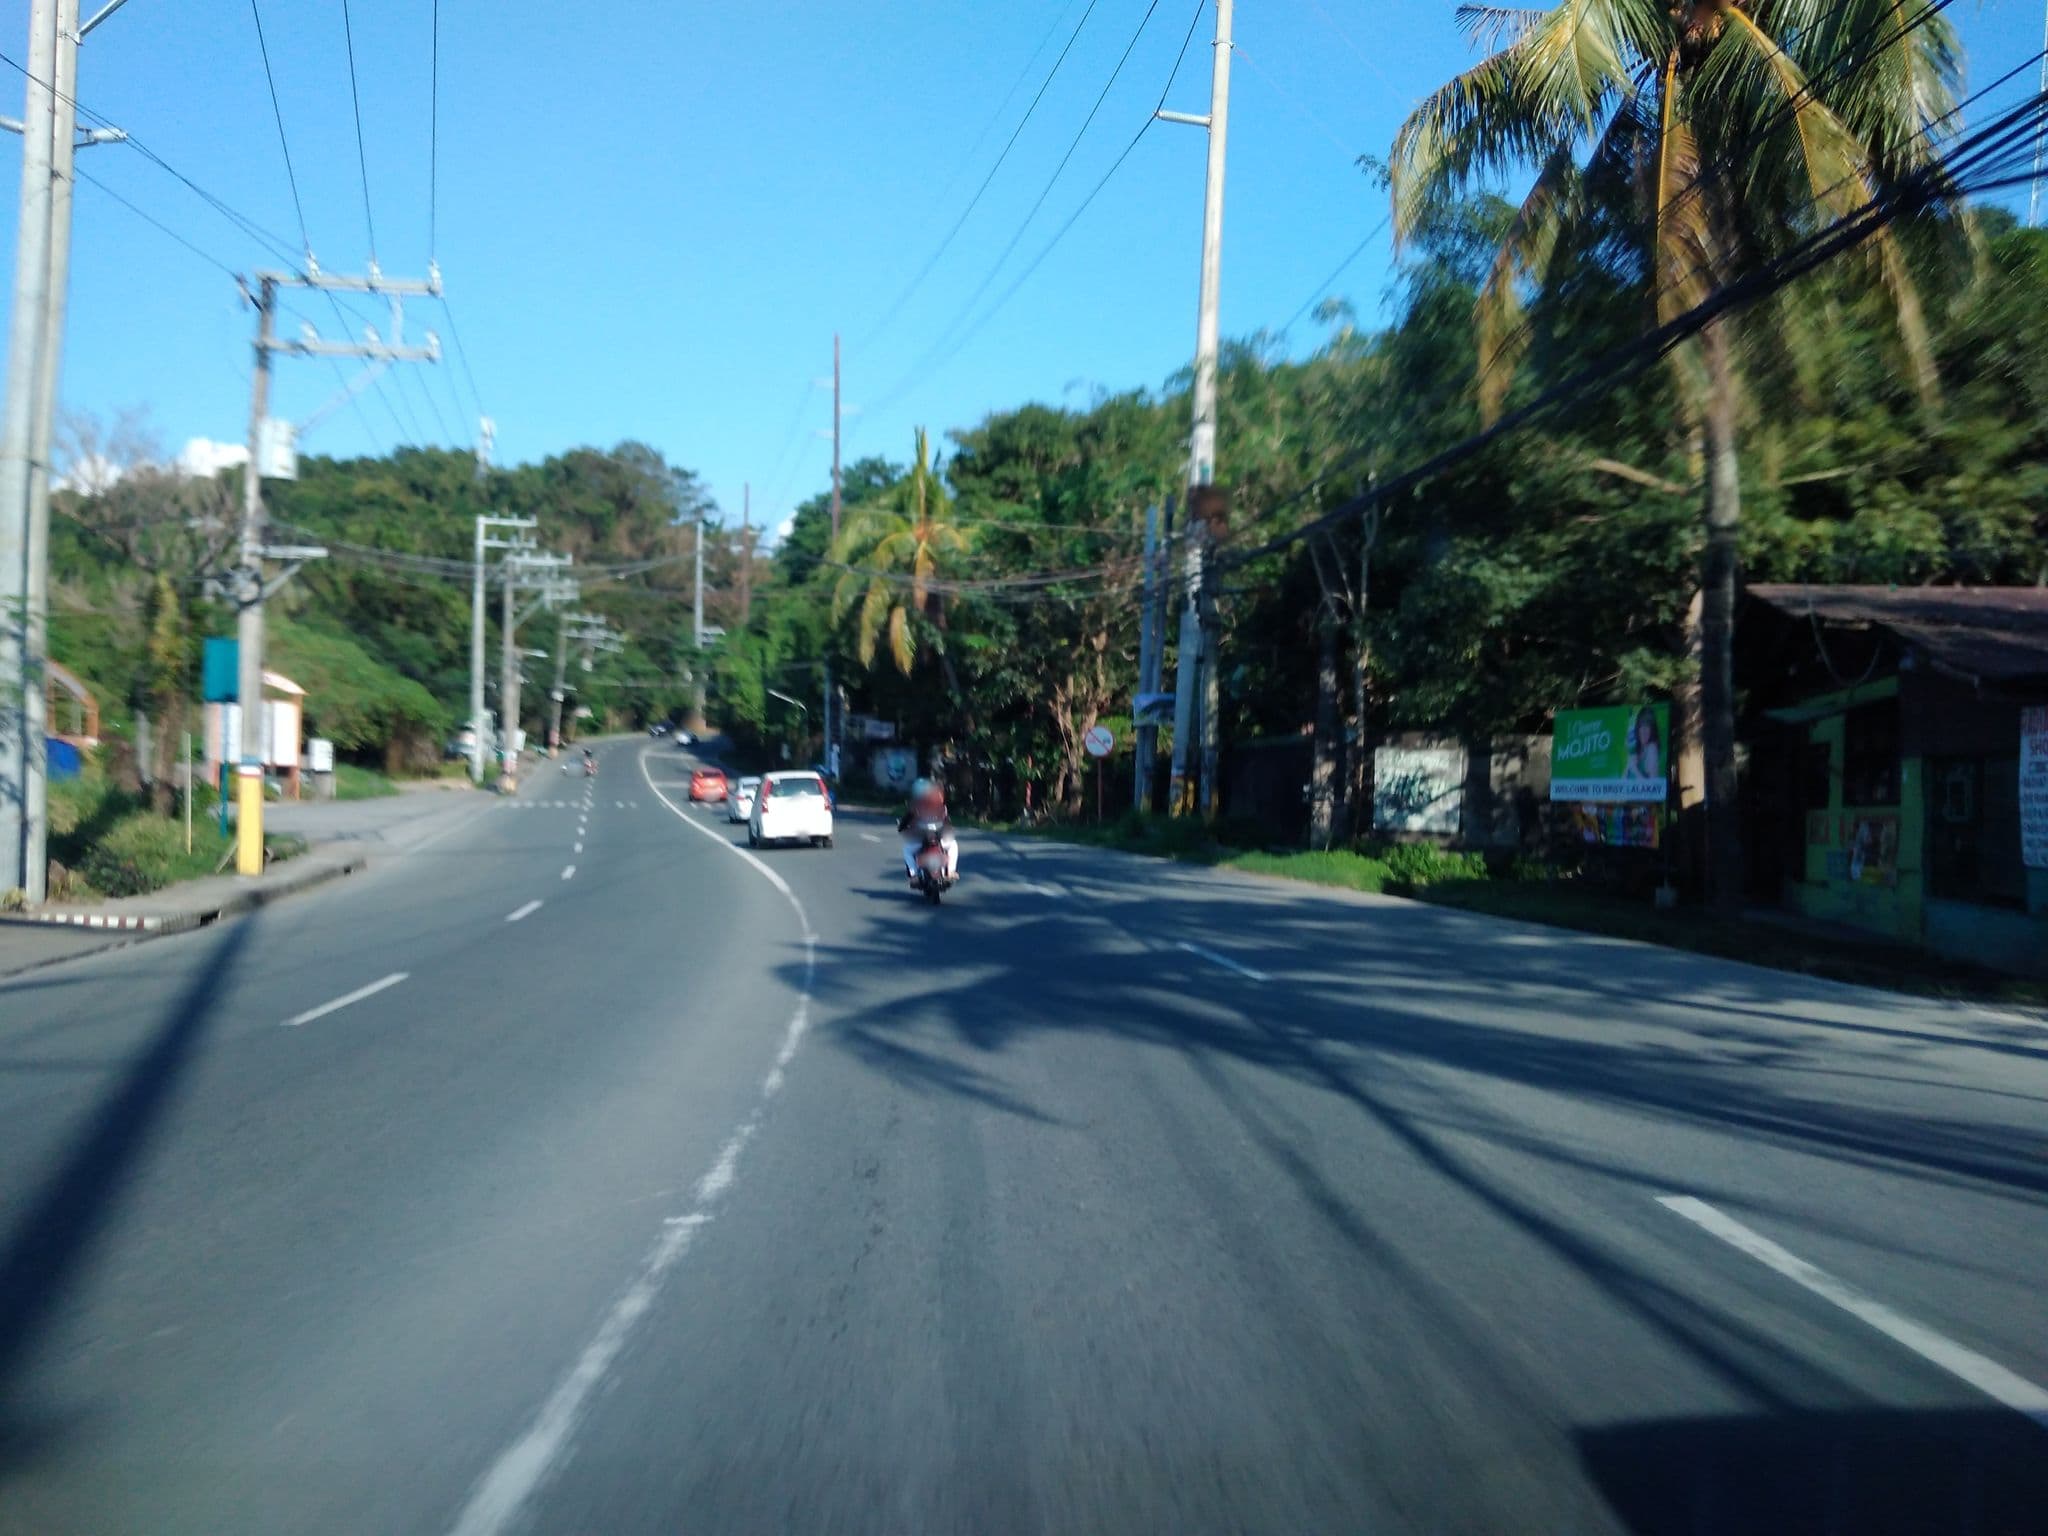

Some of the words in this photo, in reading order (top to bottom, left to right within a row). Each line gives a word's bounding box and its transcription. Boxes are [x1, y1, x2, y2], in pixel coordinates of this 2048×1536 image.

[1558, 731, 1610, 760] MOJITO
[1554, 783, 1588, 794] WELCOME
[1592, 783, 1601, 794] TO
